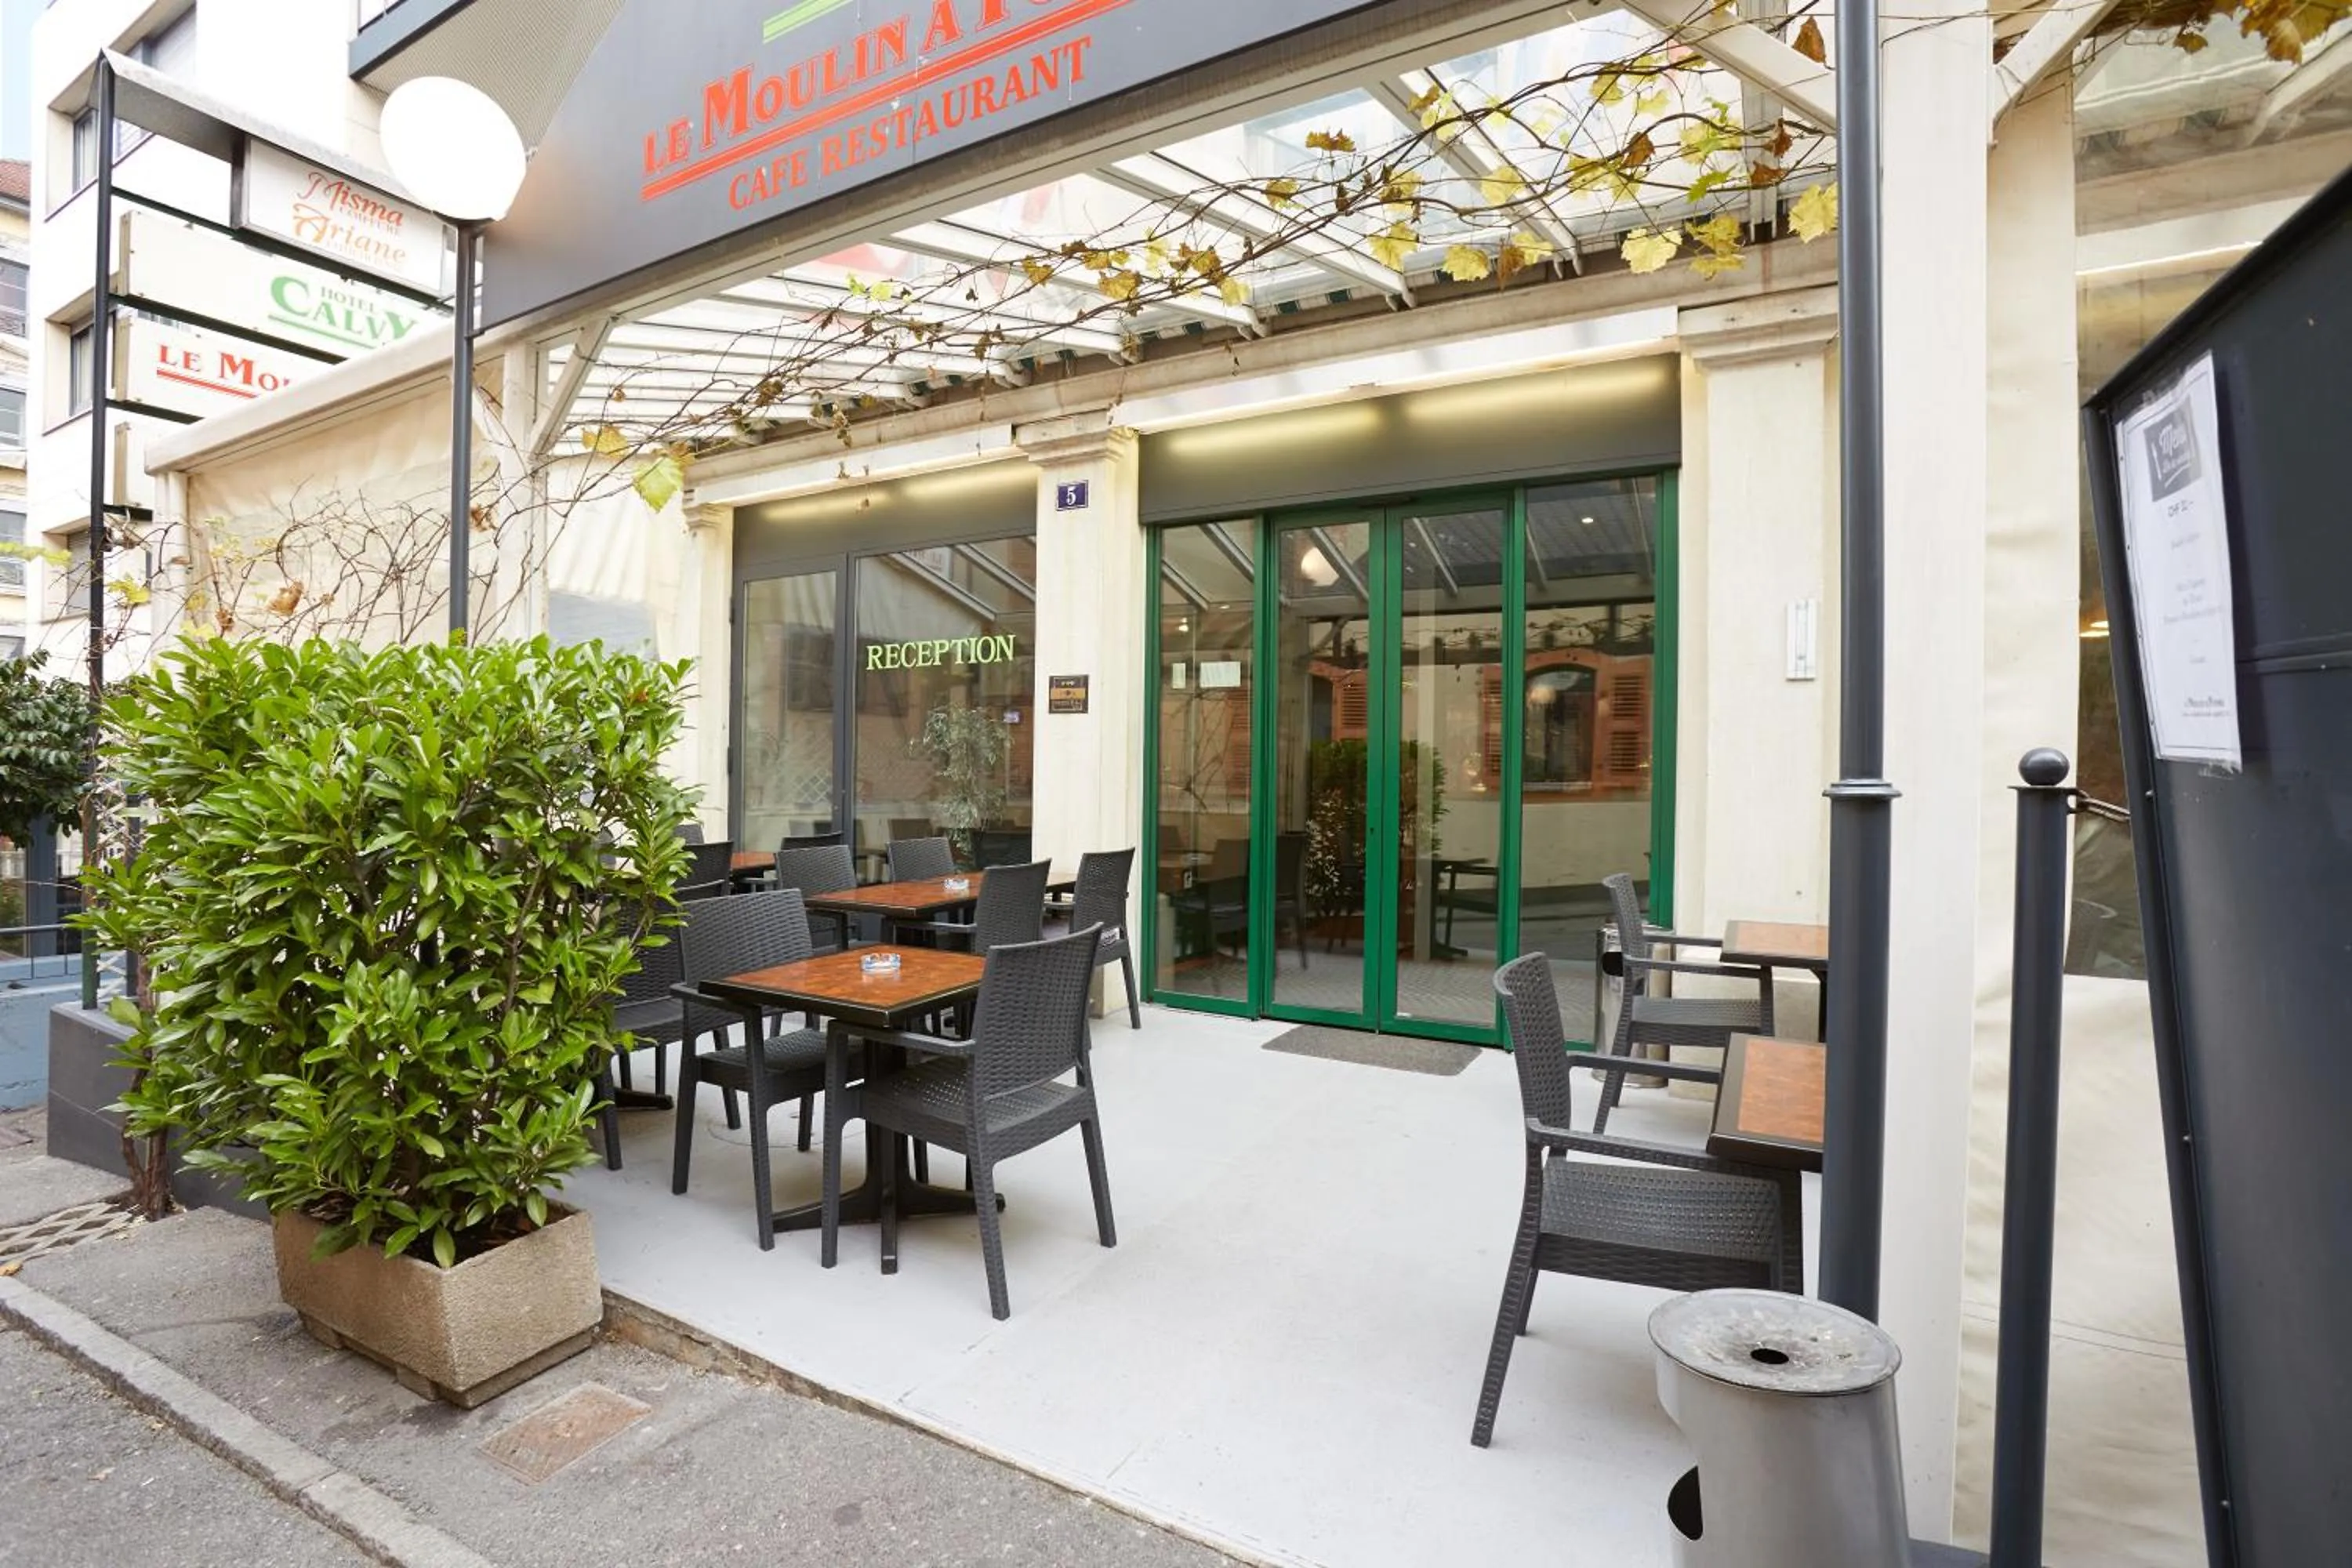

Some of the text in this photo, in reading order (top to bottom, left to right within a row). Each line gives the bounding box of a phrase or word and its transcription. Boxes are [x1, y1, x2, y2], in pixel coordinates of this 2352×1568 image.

[642, 116, 691, 177] LE
[700, 14, 909, 151] MOULIN
[728, 35, 1093, 210] CAFE RESTAURANT
[296, 172, 403, 226] Misma
[292, 203, 406, 264] Ariane
[321, 286, 376, 314] HOTEL
[158, 344, 290, 392] LE MO
[1066, 485, 1076, 506] 5
[866, 634, 1016, 670] RECEPTION
